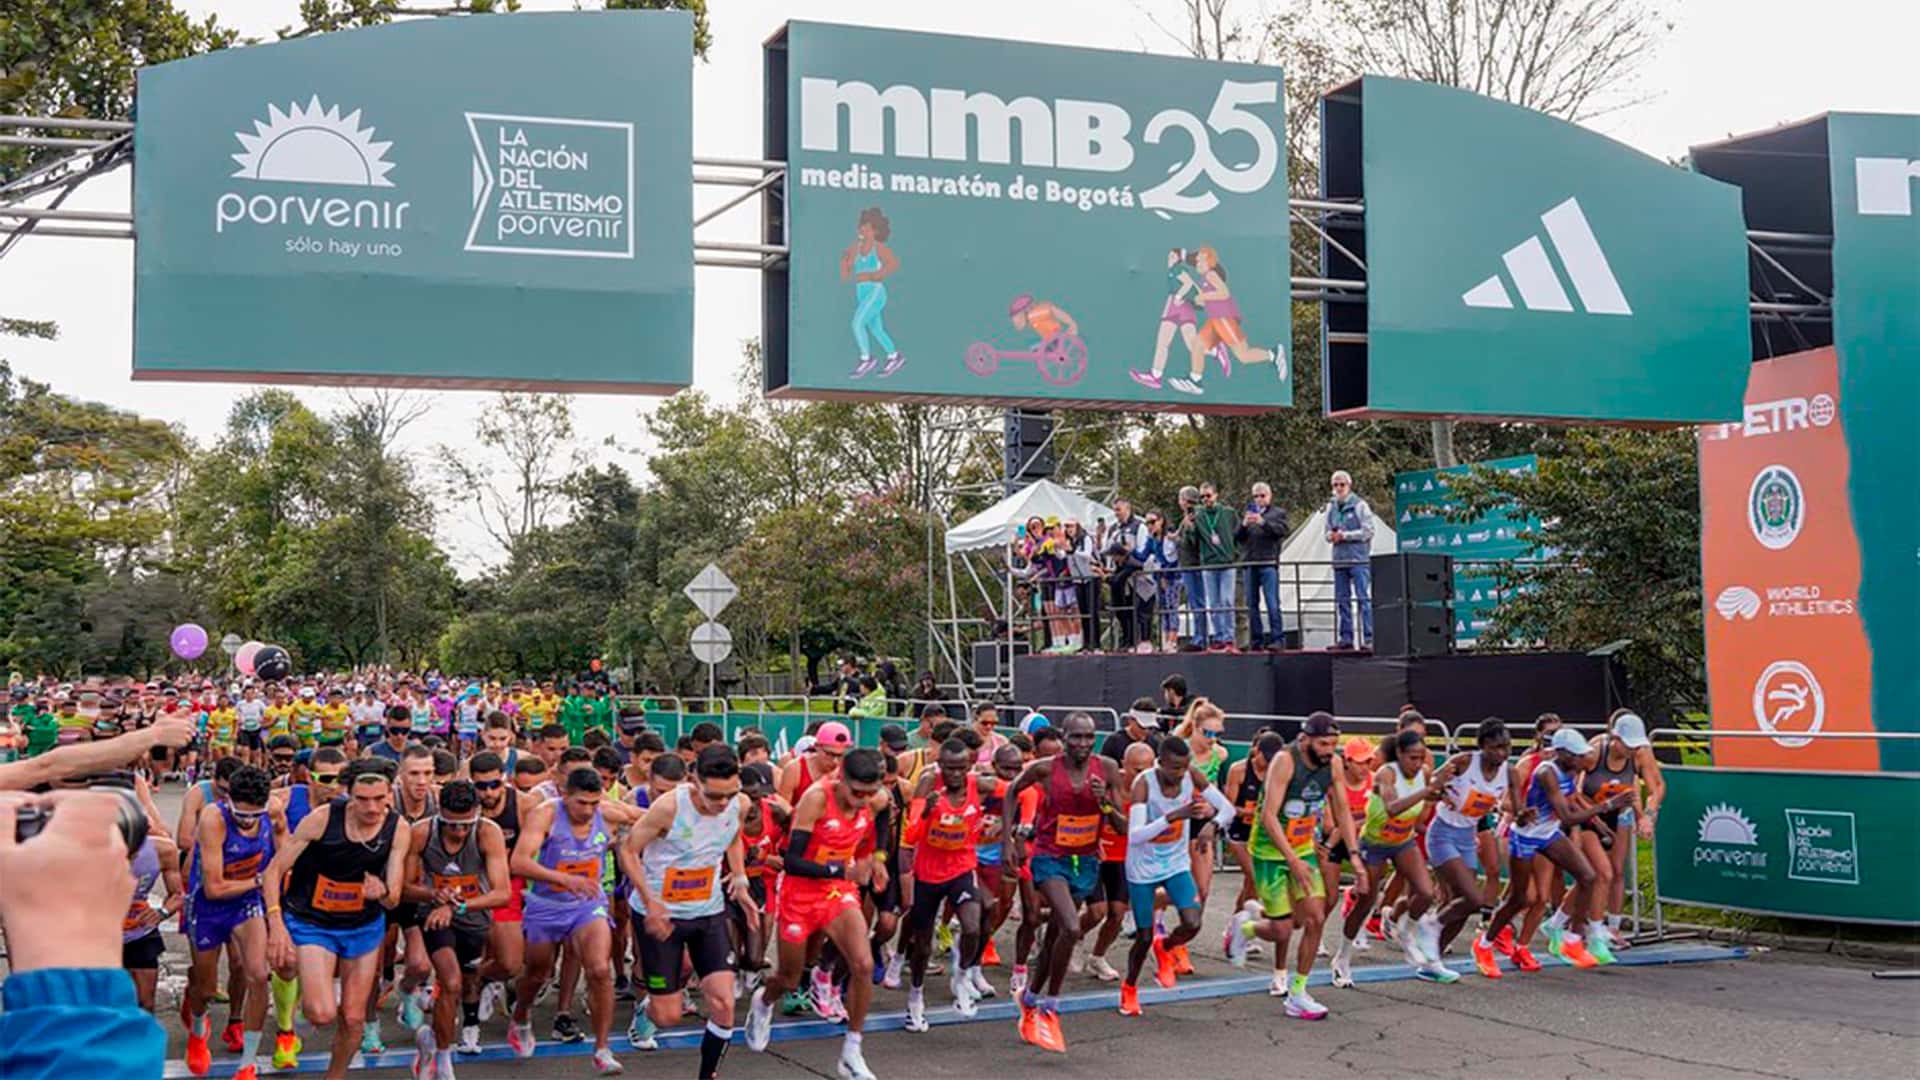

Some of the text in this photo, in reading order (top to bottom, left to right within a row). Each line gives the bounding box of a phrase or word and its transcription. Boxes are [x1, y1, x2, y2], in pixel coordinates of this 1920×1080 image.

[499, 127, 529, 147] LA
[801, 76, 1278, 217] mmB 25
[499, 144, 589, 170] NACIÓN
[499, 168, 543, 190] DEL
[801, 164, 1135, 212] media maratón de Bogotá
[215, 192, 411, 234] porvenir
[499, 190, 624, 214] ATLETISMO
[497, 213, 623, 241] porvenir
[285, 235, 402, 257] sólo hay uno
[1766, 586, 1820, 600] WORLD
